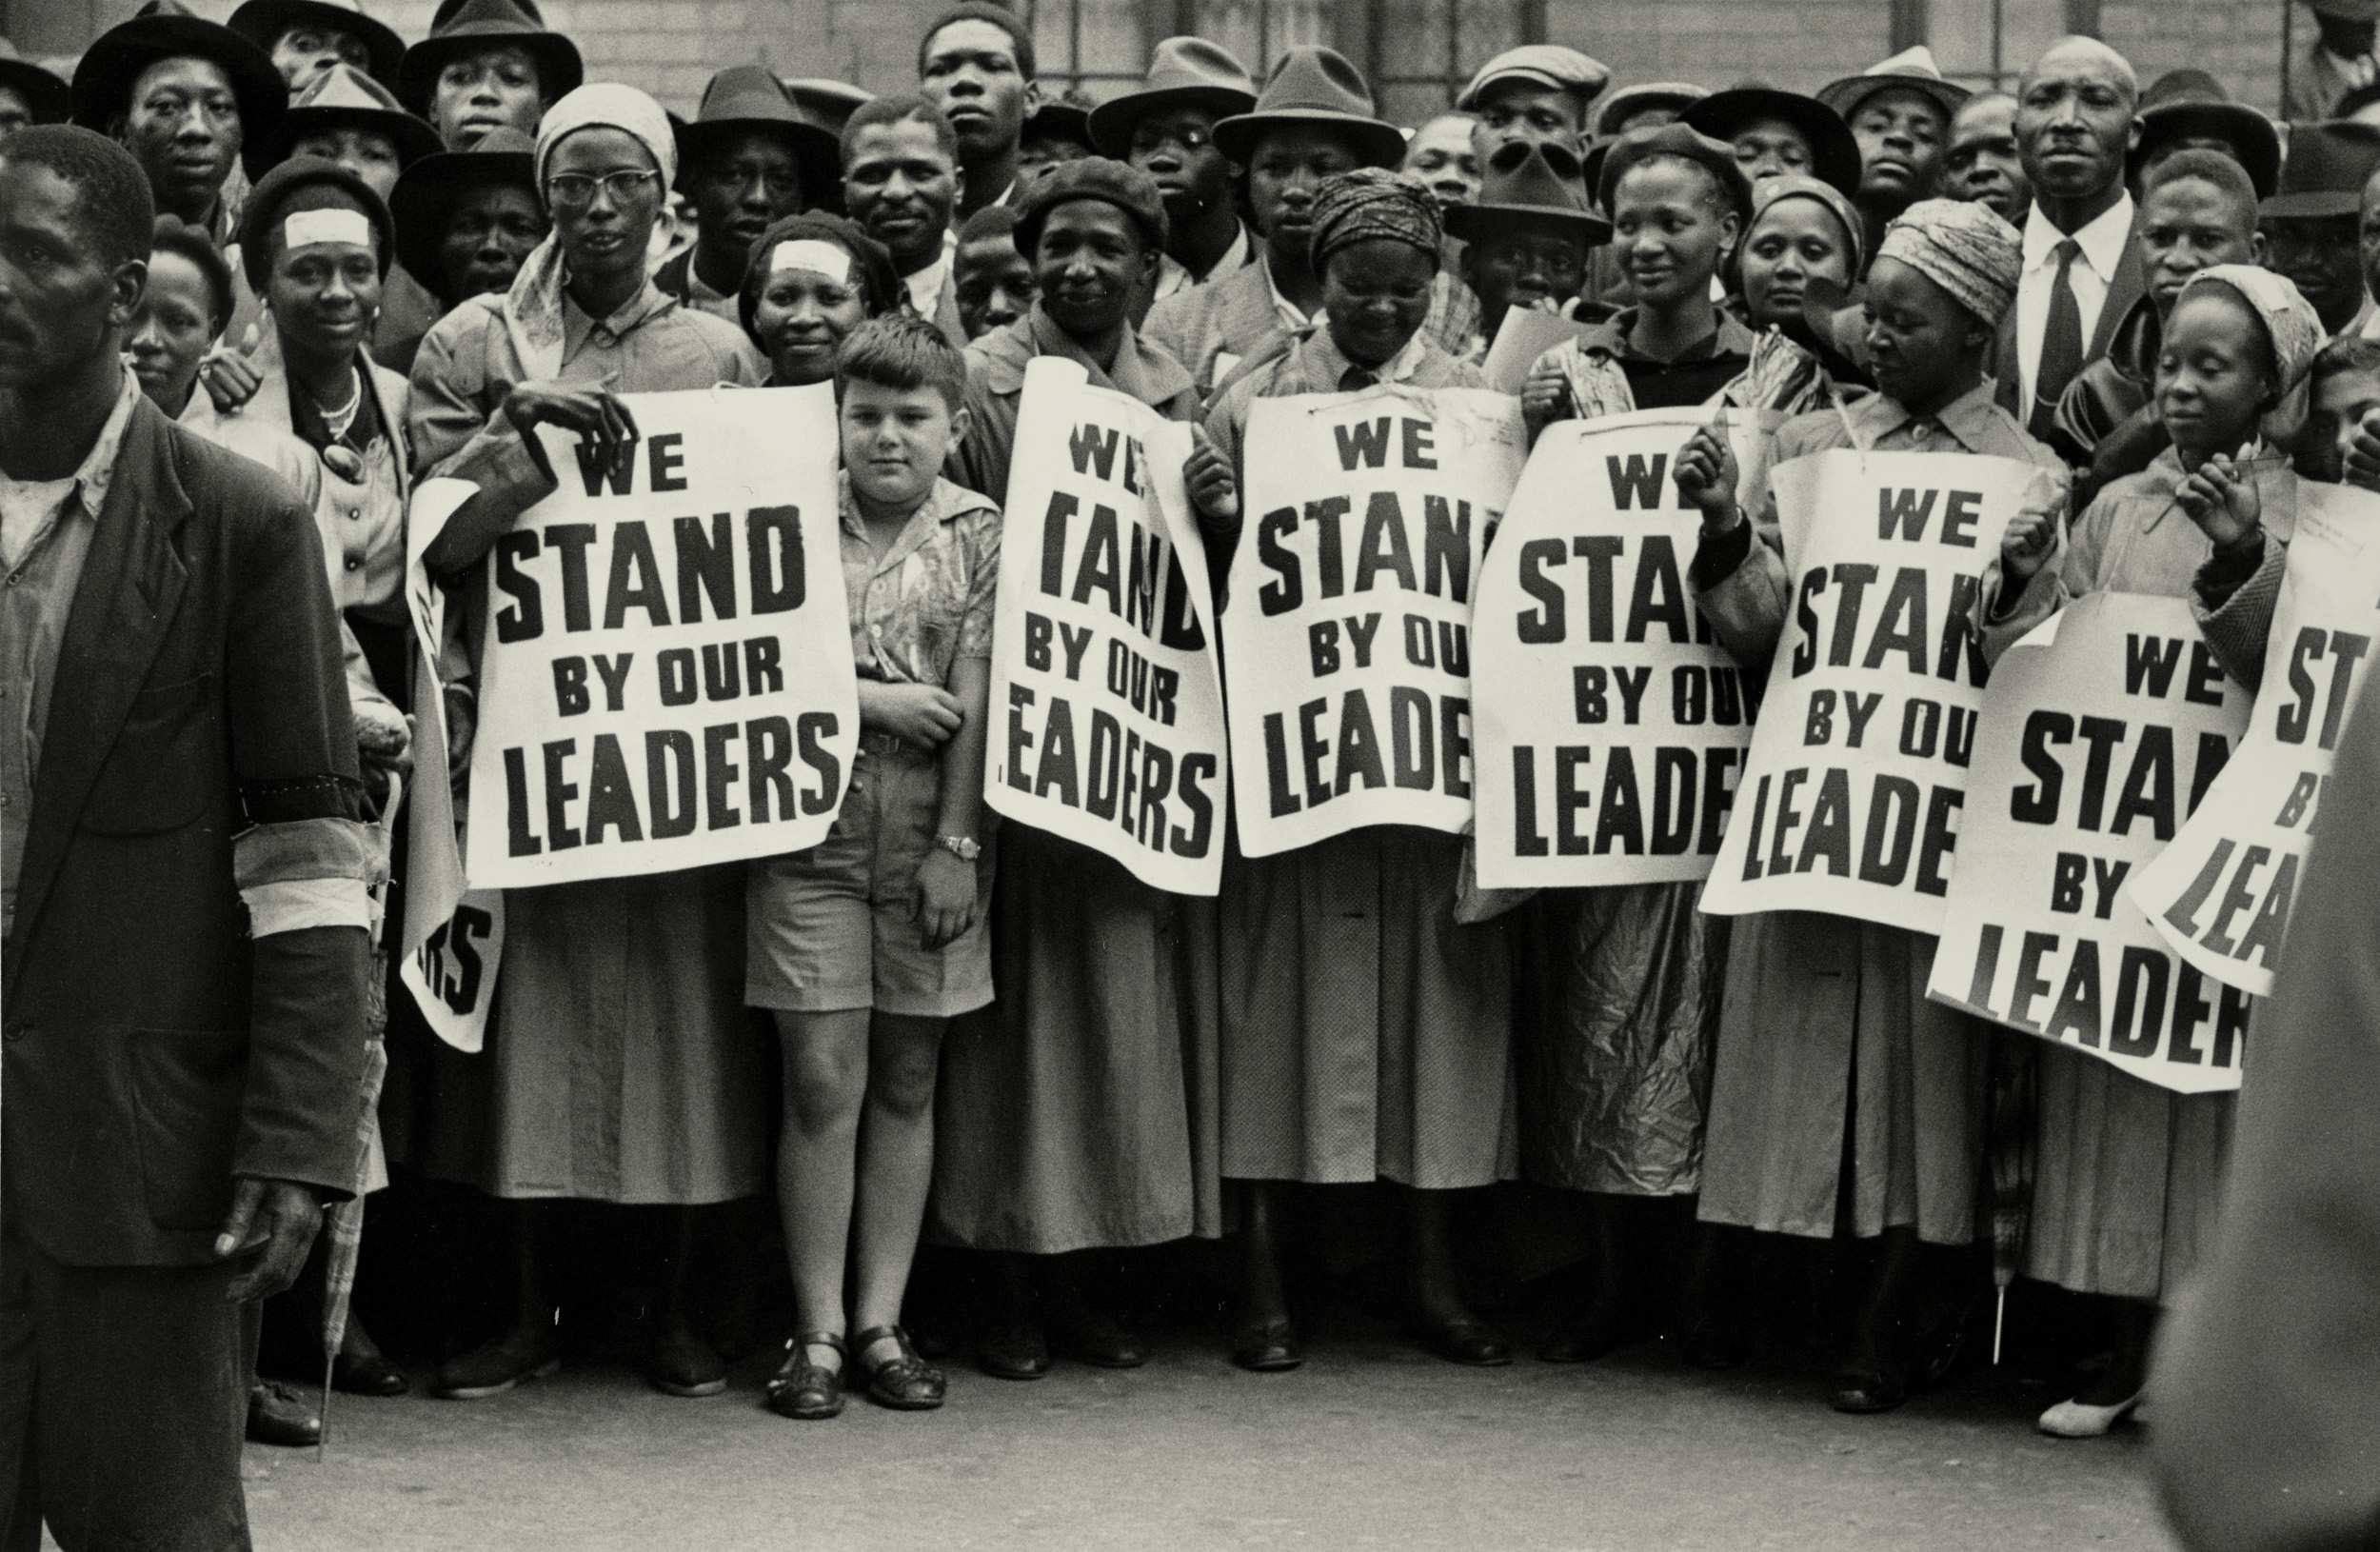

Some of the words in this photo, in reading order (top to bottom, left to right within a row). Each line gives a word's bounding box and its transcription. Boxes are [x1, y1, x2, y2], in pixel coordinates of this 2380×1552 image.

[575, 433, 687, 497] WE
[1334, 415, 1438, 471] WE
[1258, 490, 1503, 617] STAN
[1877, 487, 1984, 548] WE
[496, 505, 806, 645] STAND
[1517, 535, 1712, 646] STA
[551, 652, 634, 718] BY
[657, 635, 783, 706] OUR
[1025, 610, 1094, 682] BY
[1107, 636, 1180, 727] OUR
[1308, 612, 1383, 678] BY
[2125, 632, 2226, 706] WE
[1573, 666, 1654, 726] BY
[1803, 688, 1884, 749] BY
[504, 711, 840, 858] LEADERS
[999, 681, 1218, 859] EADERS
[1263, 685, 1472, 820] LEADE
[1513, 746, 1750, 858] LEADE
[1741, 766, 1966, 898] LEADE
[2051, 850, 2132, 921] BY
